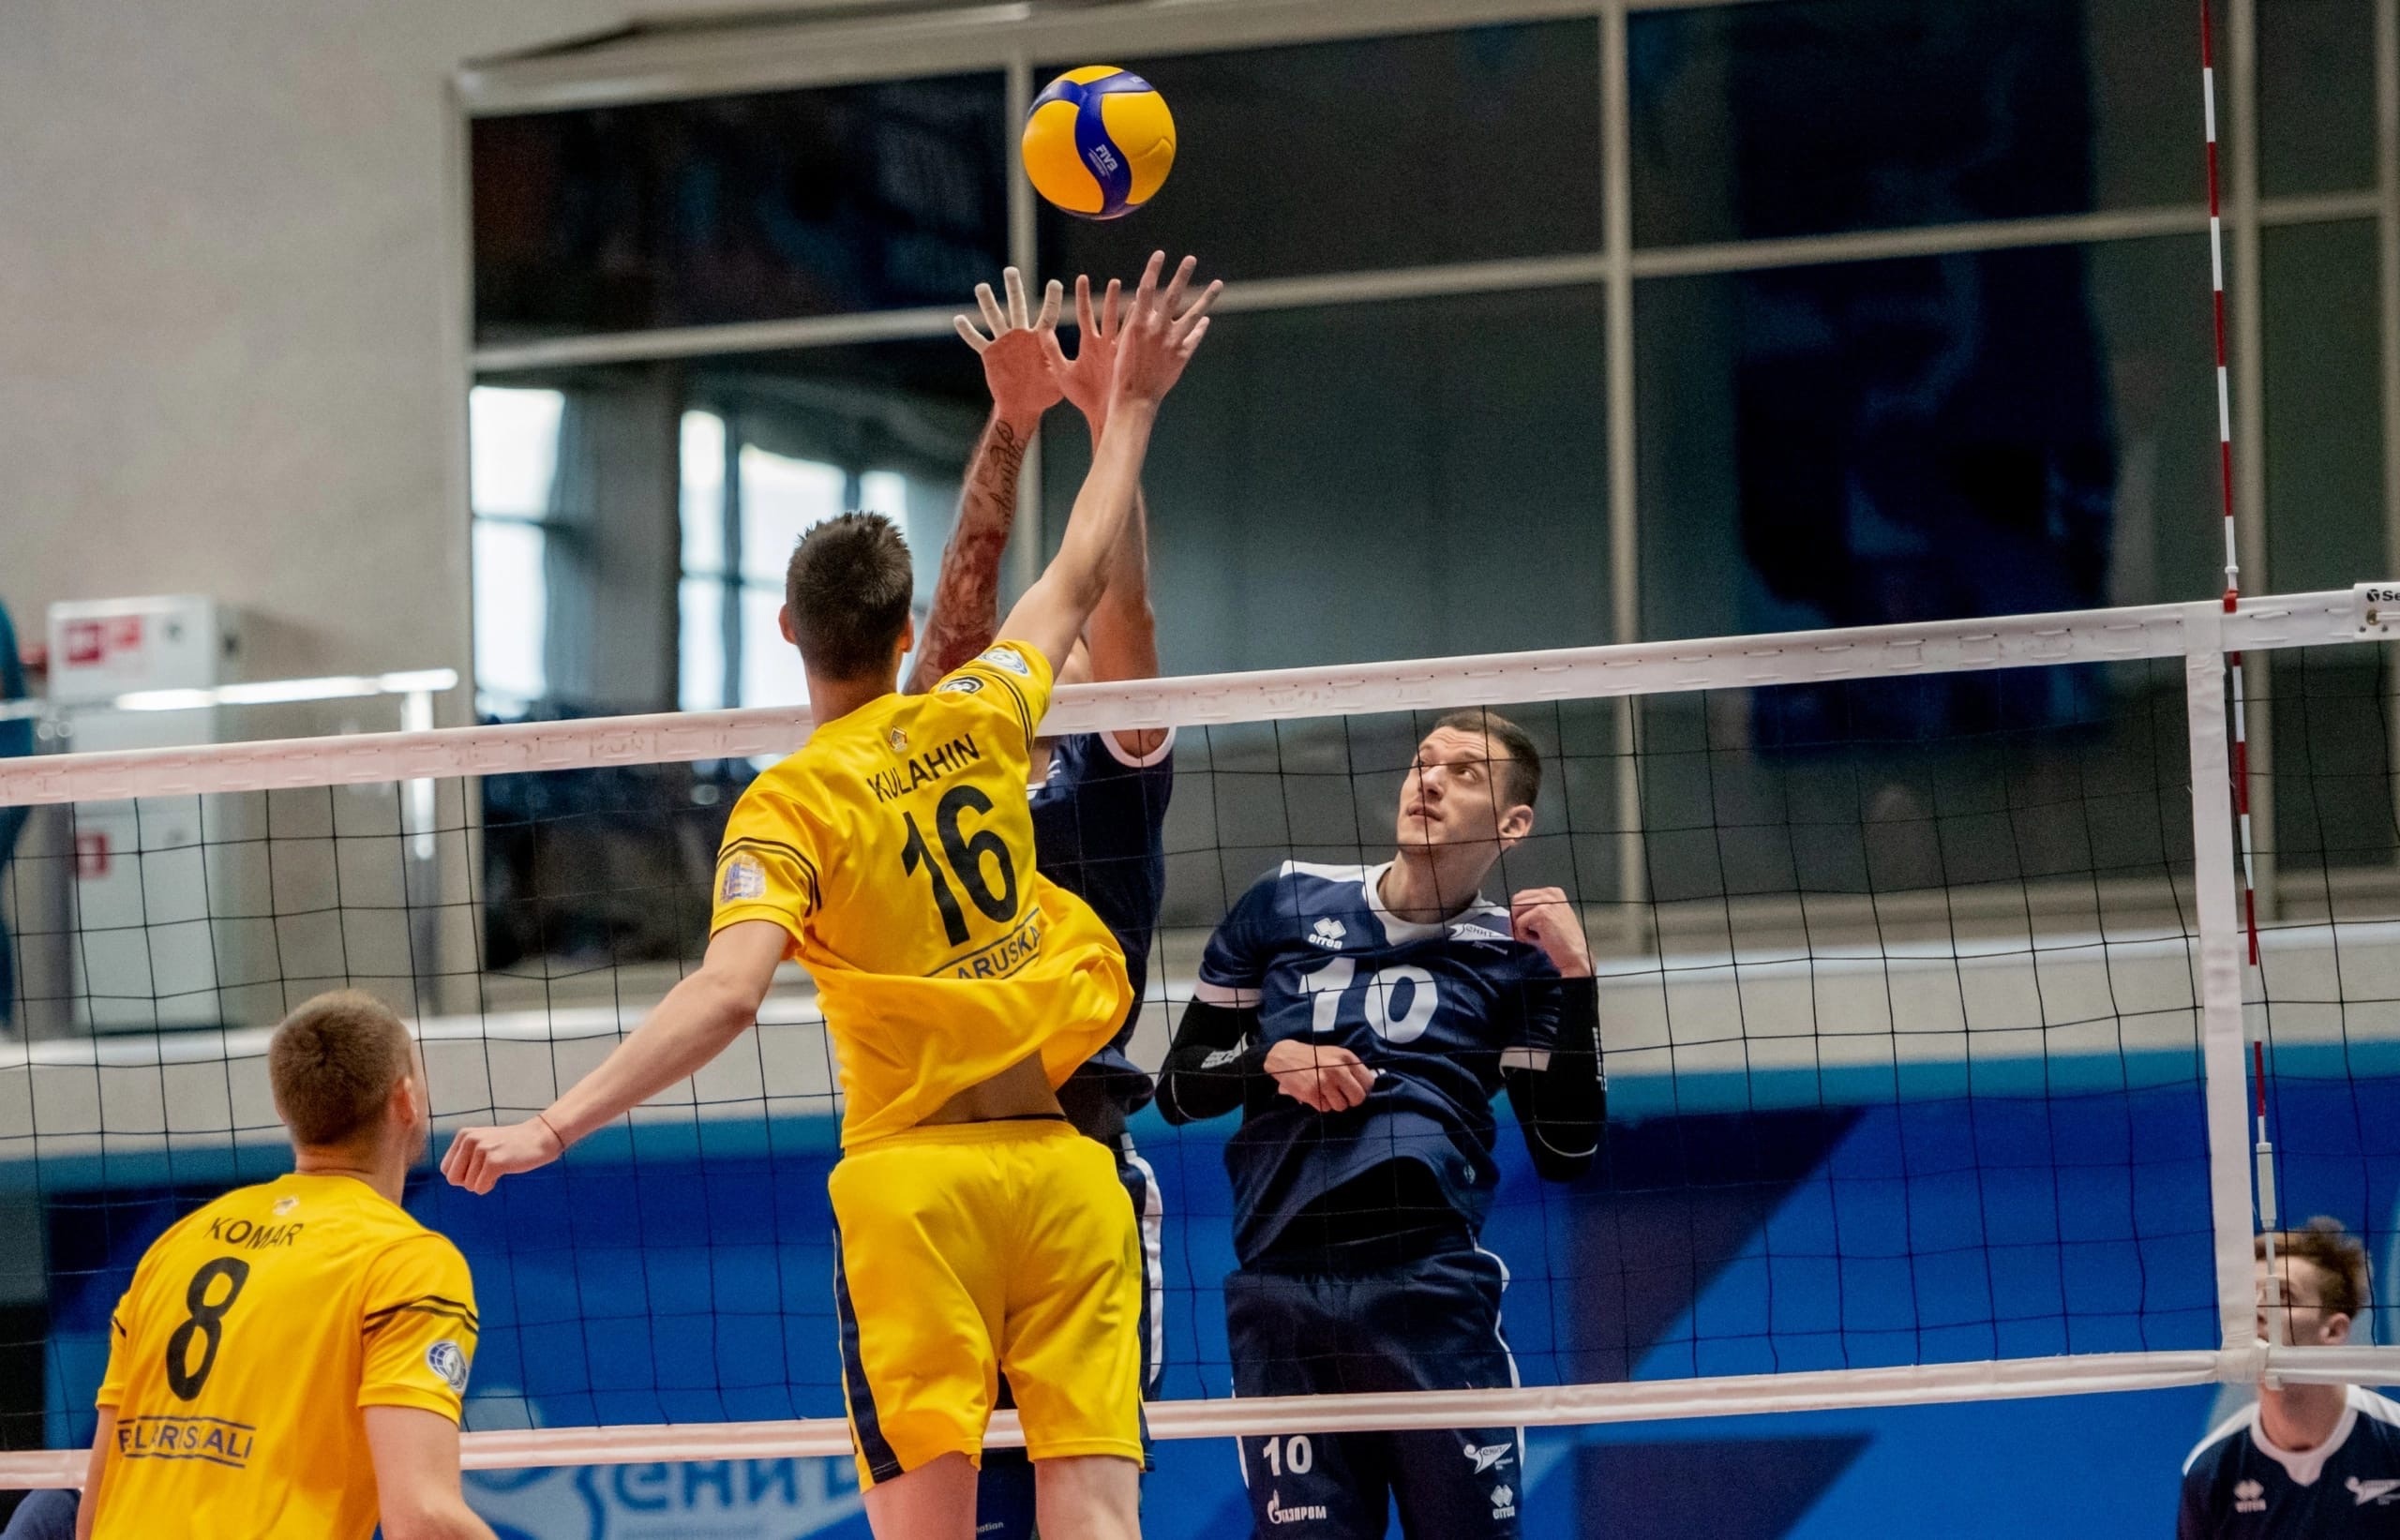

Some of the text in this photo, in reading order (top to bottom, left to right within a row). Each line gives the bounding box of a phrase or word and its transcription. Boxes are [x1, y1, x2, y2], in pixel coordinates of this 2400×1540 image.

[1095, 143, 1118, 172] FIVB
[866, 734, 981, 802] KULAHIN
[902, 785, 1018, 948] 16
[1298, 956, 1438, 1043] 10
[202, 1217, 304, 1249] KOMAR
[166, 1256, 250, 1401] 8
[1263, 1435, 1312, 1476] 10
